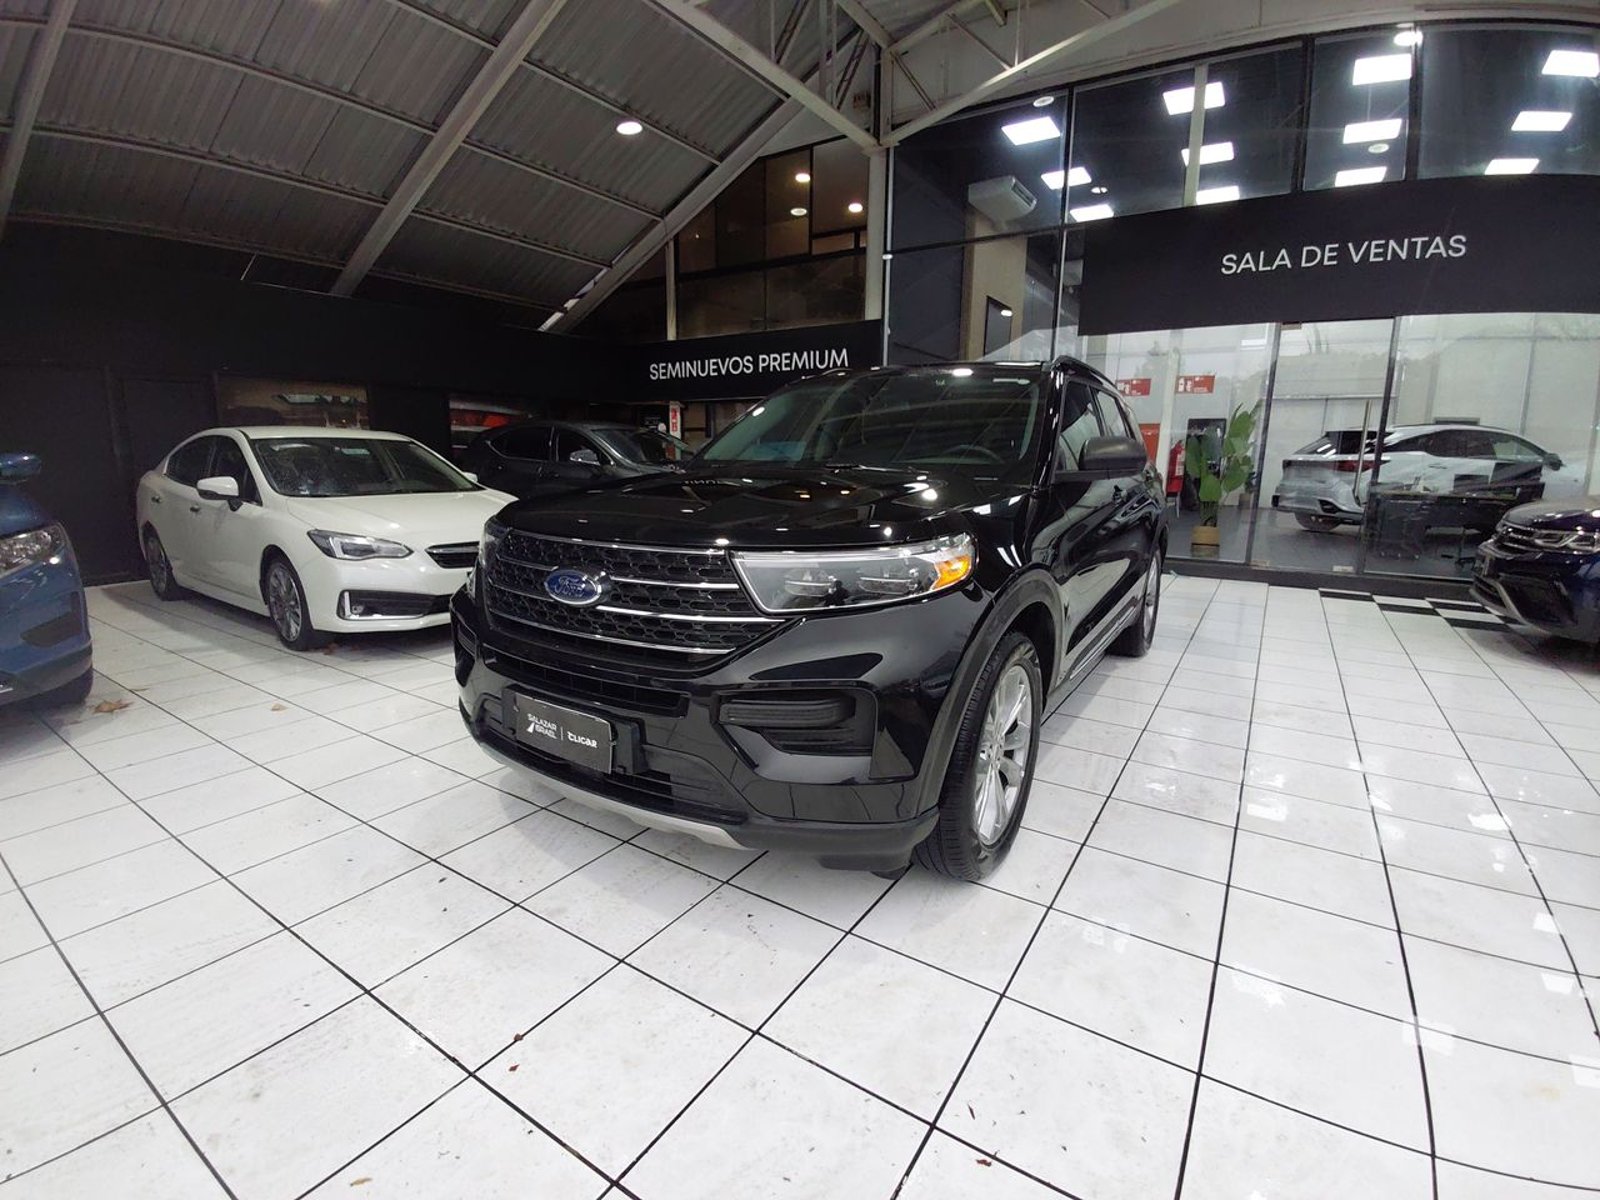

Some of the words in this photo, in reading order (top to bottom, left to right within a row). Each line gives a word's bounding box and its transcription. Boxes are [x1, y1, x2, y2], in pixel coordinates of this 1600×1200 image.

[1220, 248, 1292, 275] SALA
[1300, 243, 1340, 268] DE
[1348, 234, 1468, 264] VENTAS
[649, 355, 754, 381] SEMINUEVOS
[758, 347, 849, 373] PREMIUM
